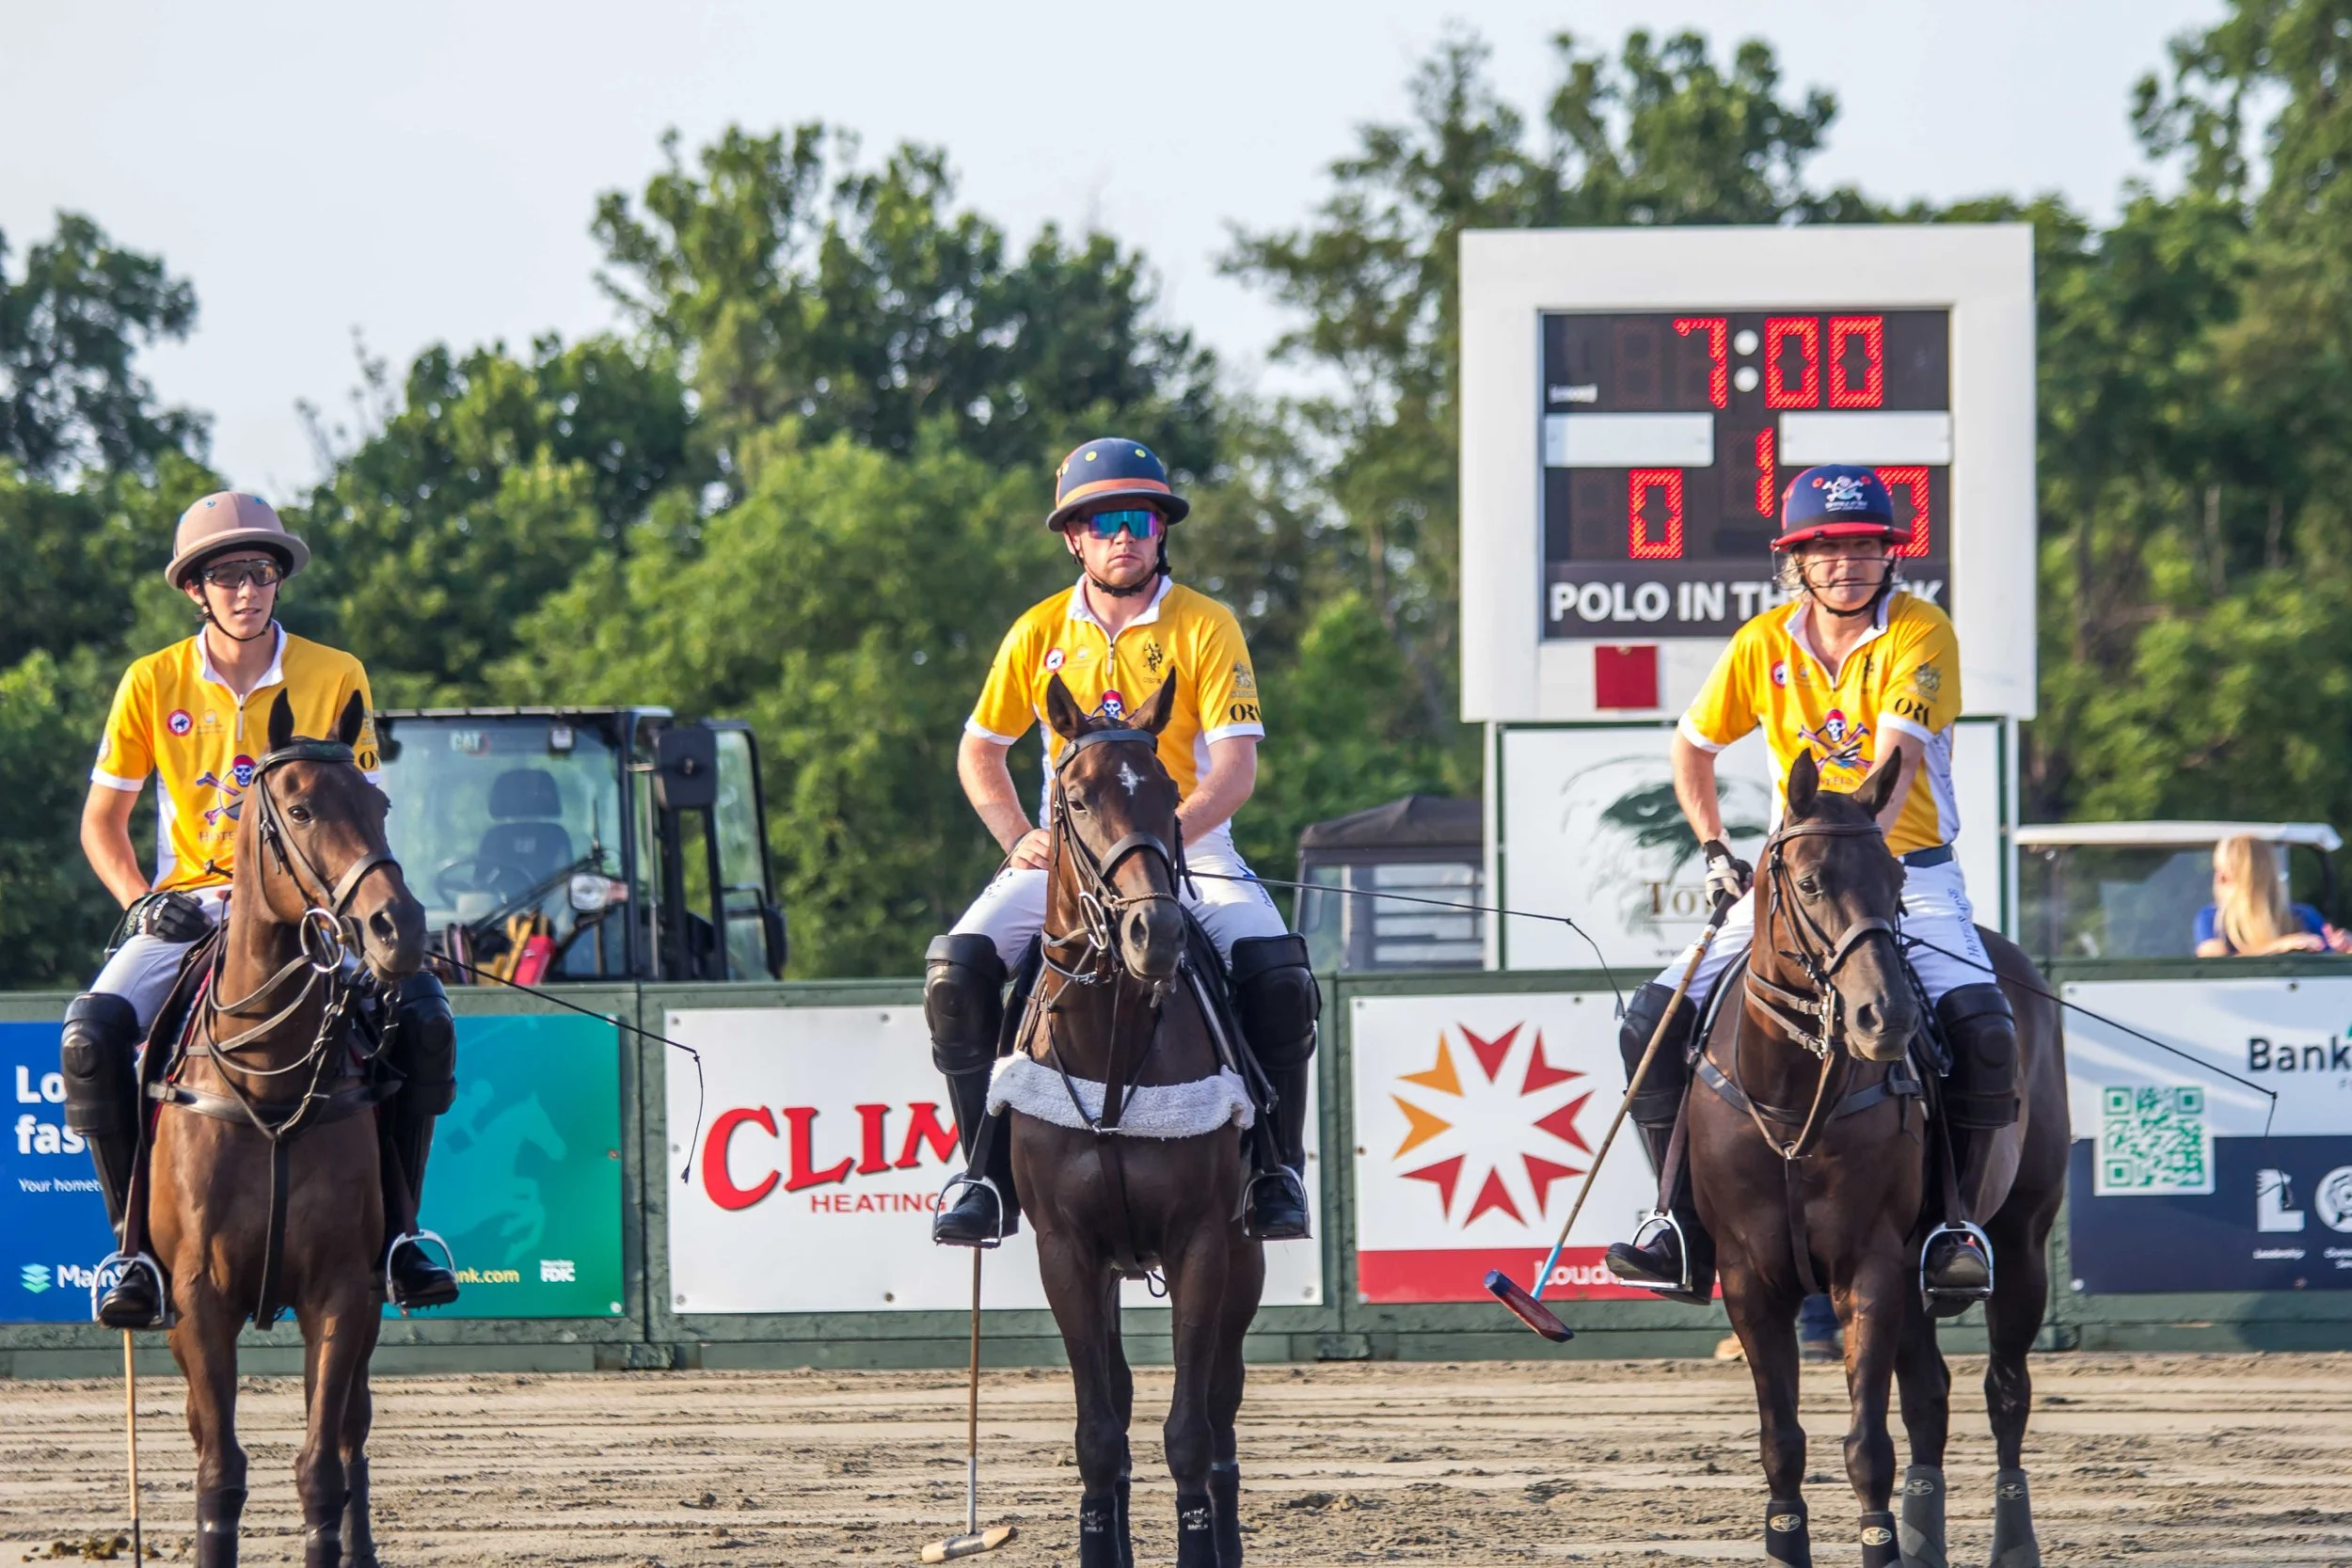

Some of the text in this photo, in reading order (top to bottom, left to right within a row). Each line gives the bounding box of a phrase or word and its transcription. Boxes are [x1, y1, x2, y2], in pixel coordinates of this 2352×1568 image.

[1673, 316, 1883, 408] 7:00
[1756, 427, 1774, 517] 1
[1629, 468, 1682, 559] 0
[1550, 581, 1788, 623] POLO IN TH
[2249, 1035, 2352, 1071] Bank
[14, 1114, 92, 1154] fas
[18, 1178, 52, 1193] Your
[811, 1192, 946, 1213] HEATING
[456, 1267, 520, 1283] nk.com
[1534, 1259, 1622, 1286] Loud
